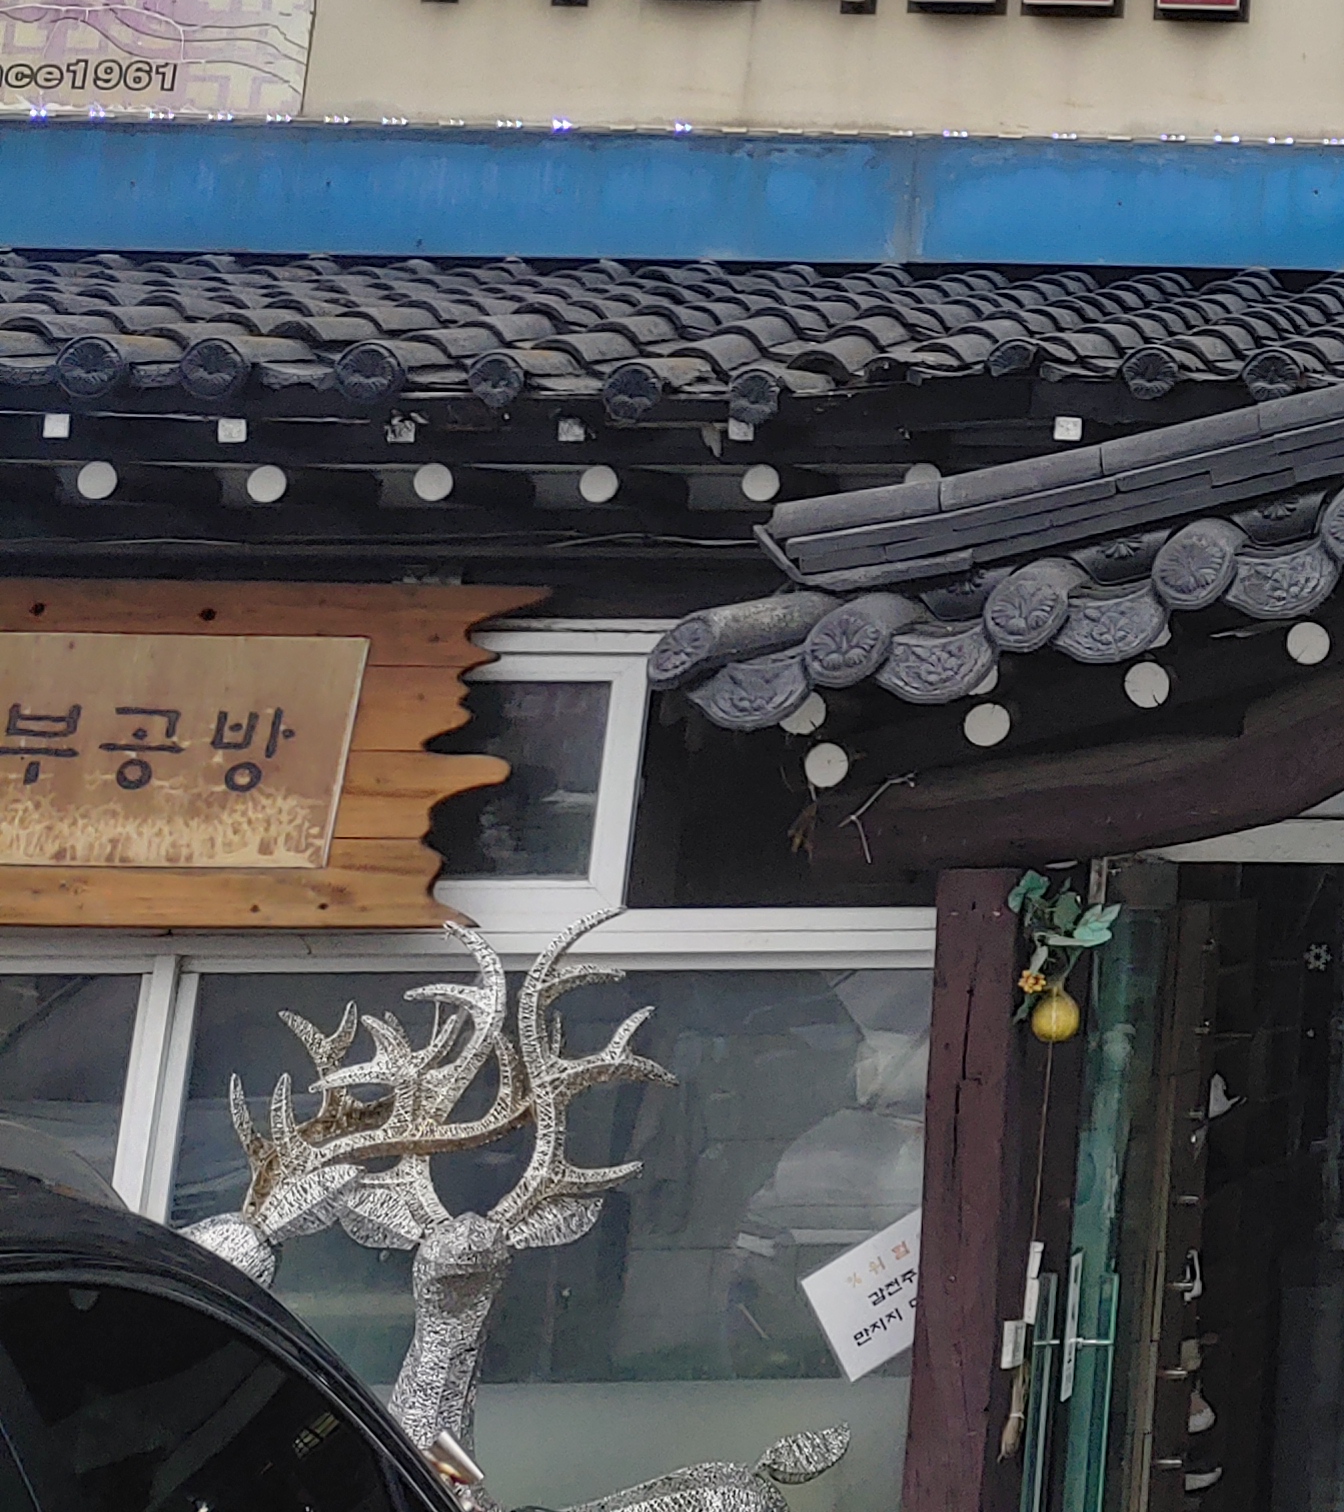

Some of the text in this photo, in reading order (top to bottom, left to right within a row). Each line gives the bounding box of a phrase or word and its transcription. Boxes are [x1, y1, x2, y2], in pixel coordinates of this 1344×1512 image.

[0, 59, 178, 92] ce1961
[0, 702, 296, 792] 부공방
[853, 1308, 903, 1347] 만지지
